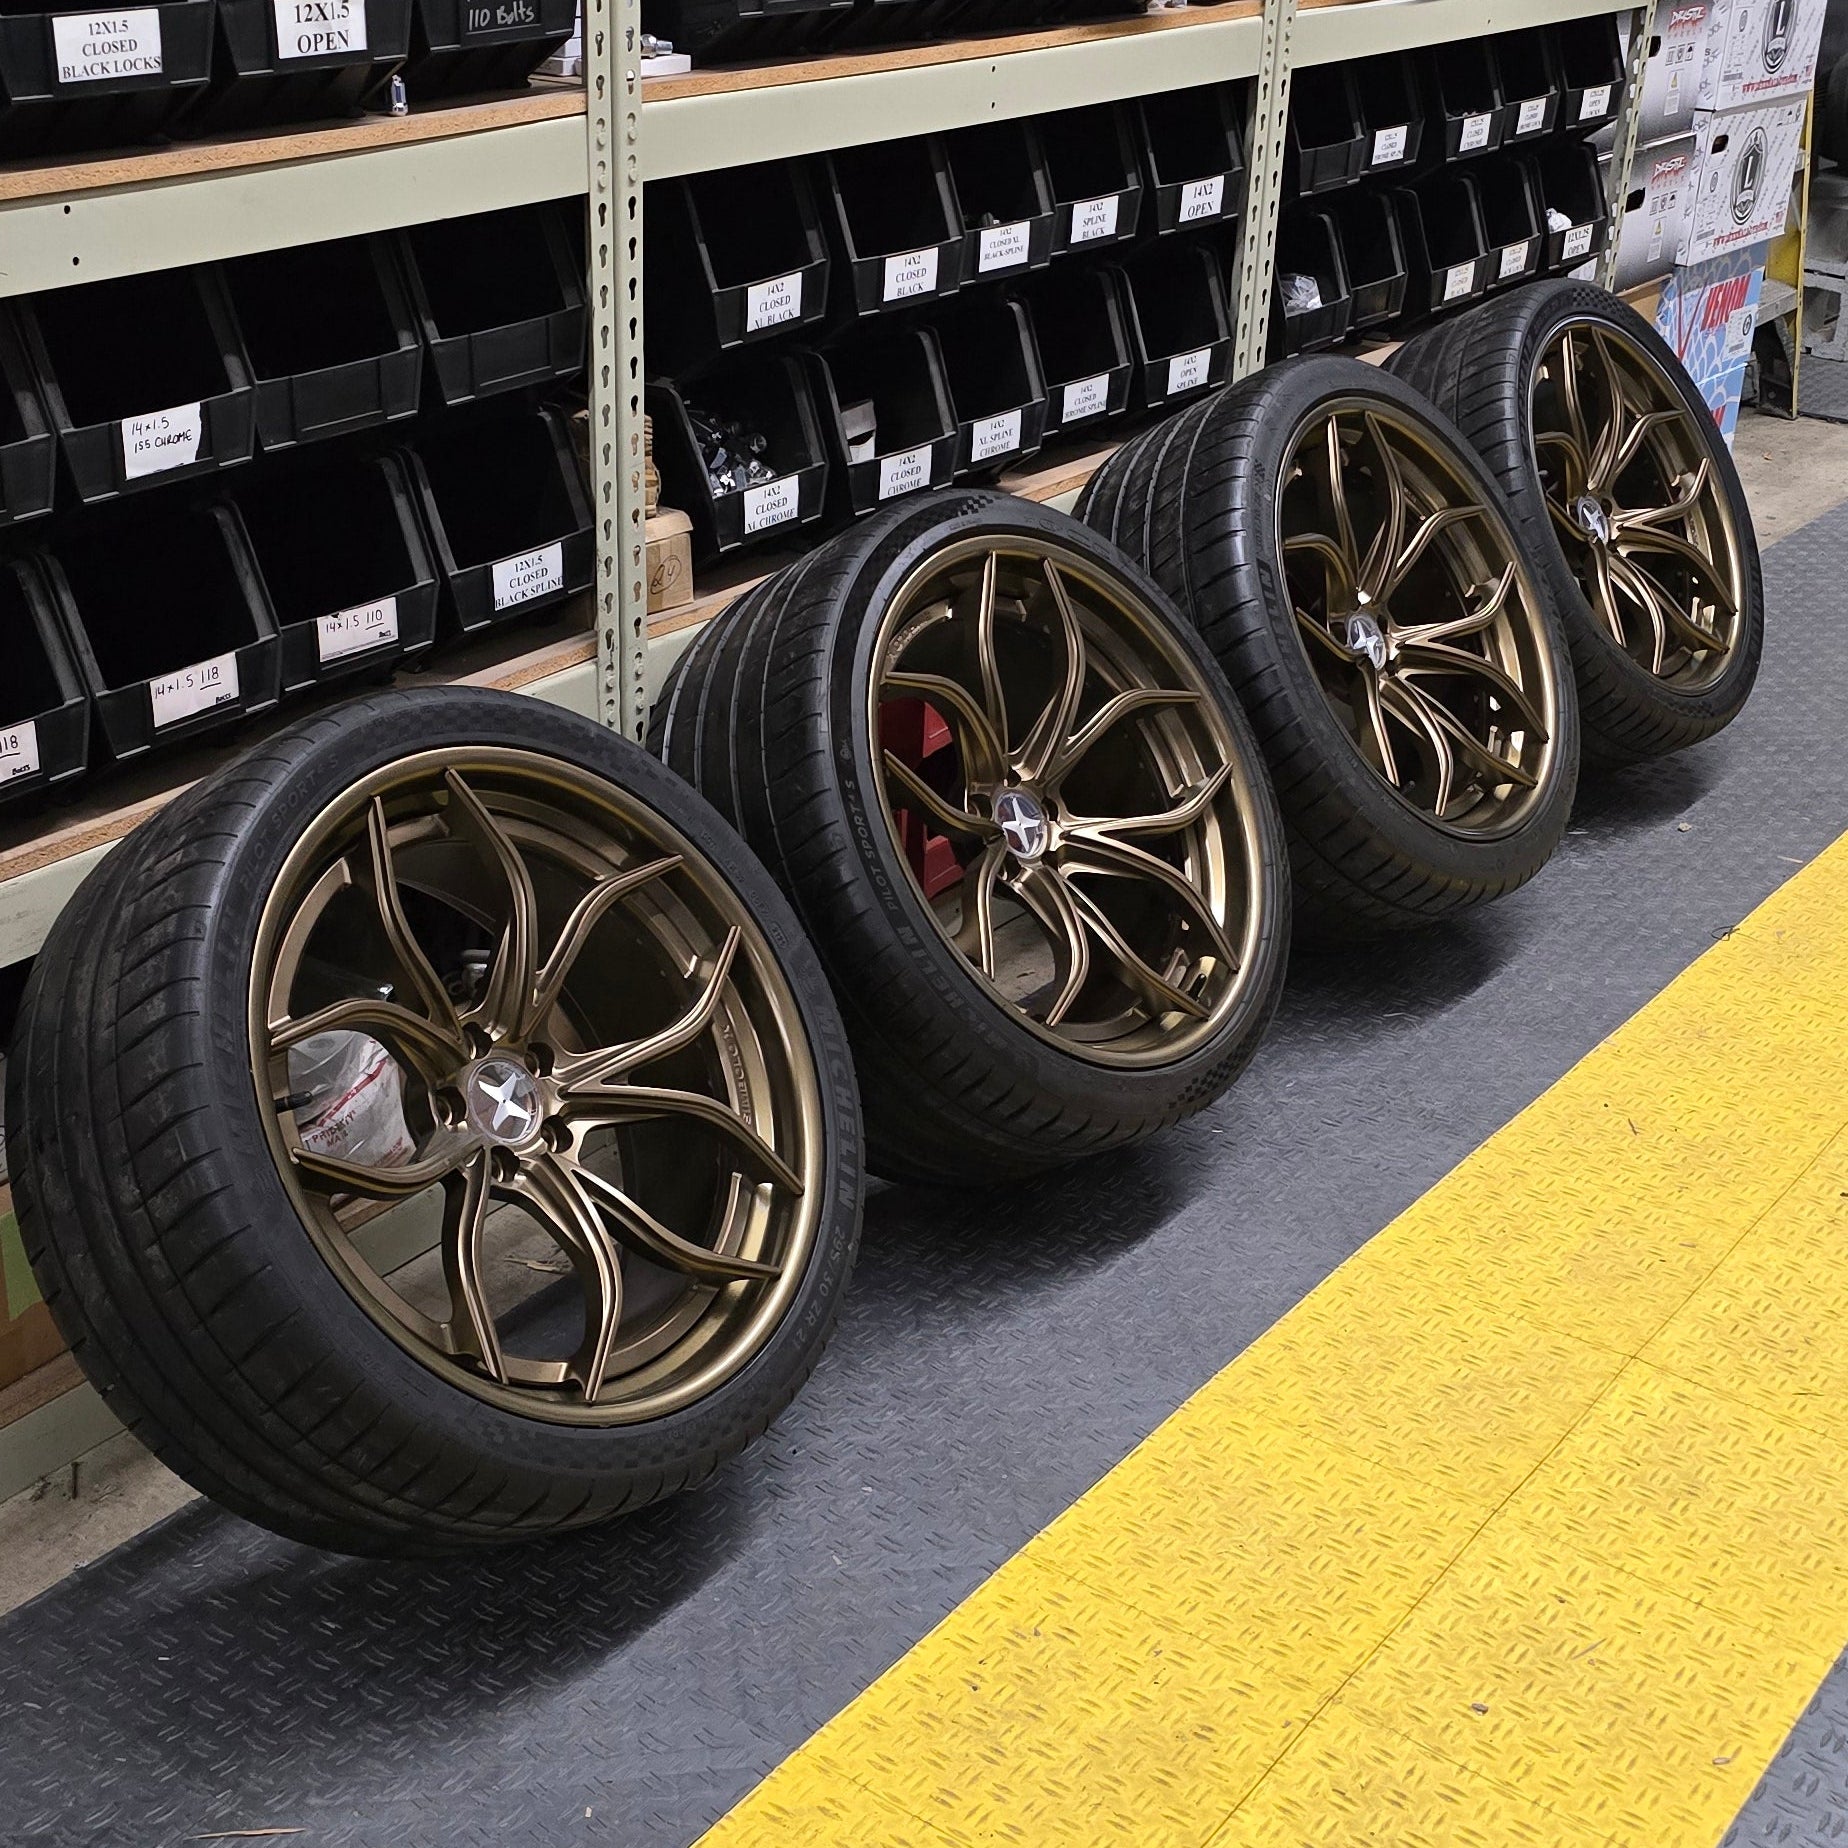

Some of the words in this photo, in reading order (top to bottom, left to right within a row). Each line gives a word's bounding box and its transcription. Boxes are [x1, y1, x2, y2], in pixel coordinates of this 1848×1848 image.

[294, 1, 350, 24] 12X1.5
[469, 8, 491, 31] 110
[88, 19, 129, 36] 12X1.5
[82, 39, 138, 57] CLOSED
[297, 29, 351, 54] OPEN
[62, 61, 111, 80] BLACK
[114, 55, 162, 73] LOCKS
[1192, 183, 1214, 199] 14X2
[1187, 202, 1215, 218] OPEN
[1082, 213, 1107, 227] SPLINE
[904, 255, 921, 268] 14X2
[895, 267, 927, 284] CLOSED
[767, 282, 785, 297] 14X2
[896, 282, 925, 297] BLACK
[759, 295, 791, 313] CLOSED
[767, 307, 795, 325] BLACK
[979, 441, 1011, 458] CHROME
[899, 454, 916, 467] 14X2
[890, 465, 922, 483] CLOSED
[763, 486, 781, 499] 14X2
[887, 478, 922, 496] CHROME
[755, 497, 788, 516] CLOSED
[759, 508, 796, 526] CHROME
[514, 555, 543, 573] 12X1.5
[509, 567, 549, 589] CLOSED
[495, 588, 529, 609] BLACK
[365, 608, 383, 625] 110
[200, 666, 220, 684] 118
[271, 769, 316, 833] SPORT
[851, 806, 876, 859] SPORT
[870, 866, 898, 911] PILOT
[814, 1005, 857, 1210] MICHELIN
